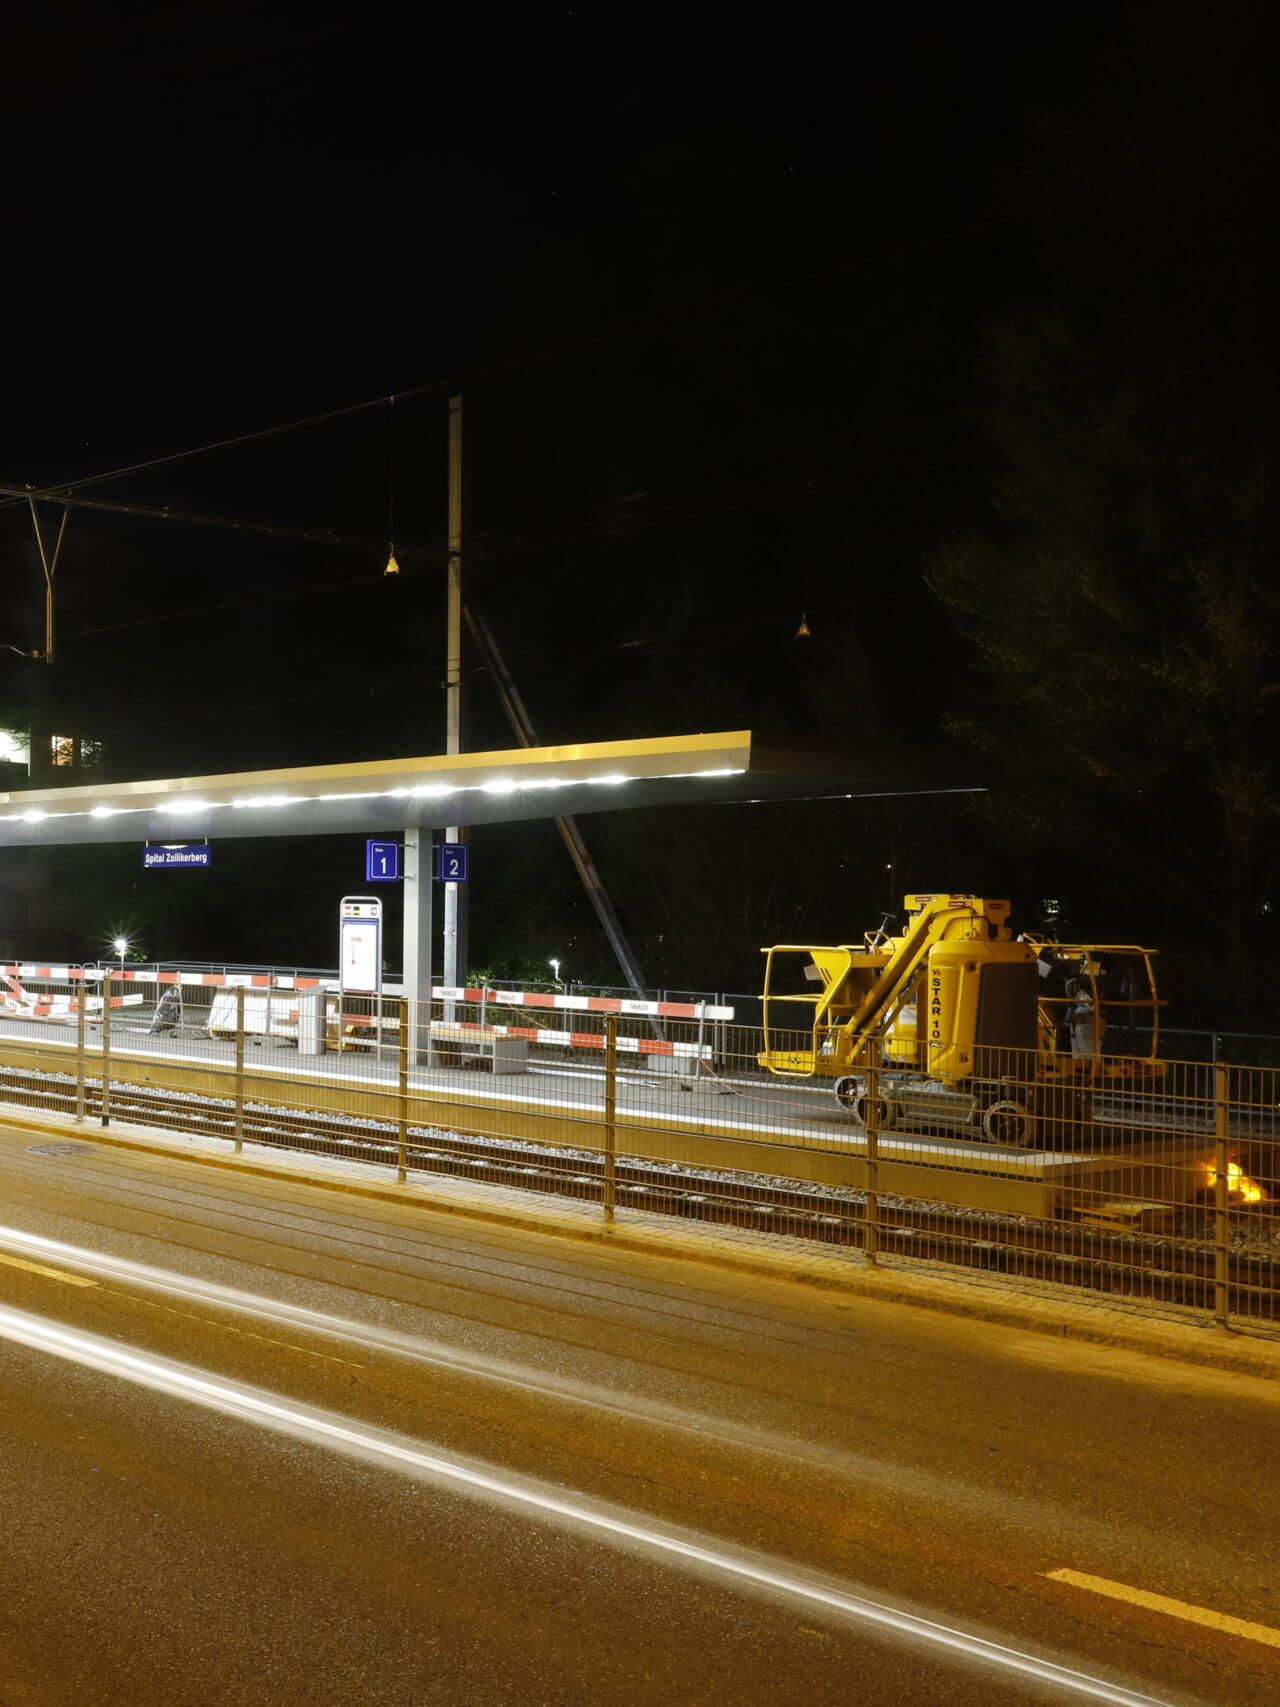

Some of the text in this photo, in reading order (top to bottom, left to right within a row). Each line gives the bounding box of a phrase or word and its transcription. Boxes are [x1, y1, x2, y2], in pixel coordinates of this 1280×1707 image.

[145, 851, 208, 865] Spital Zollikerberg
[380, 856, 387, 874] 1
[449, 858, 459, 876] 2
[932, 978, 941, 1015] STAR
[932, 1020, 940, 1039] 10
